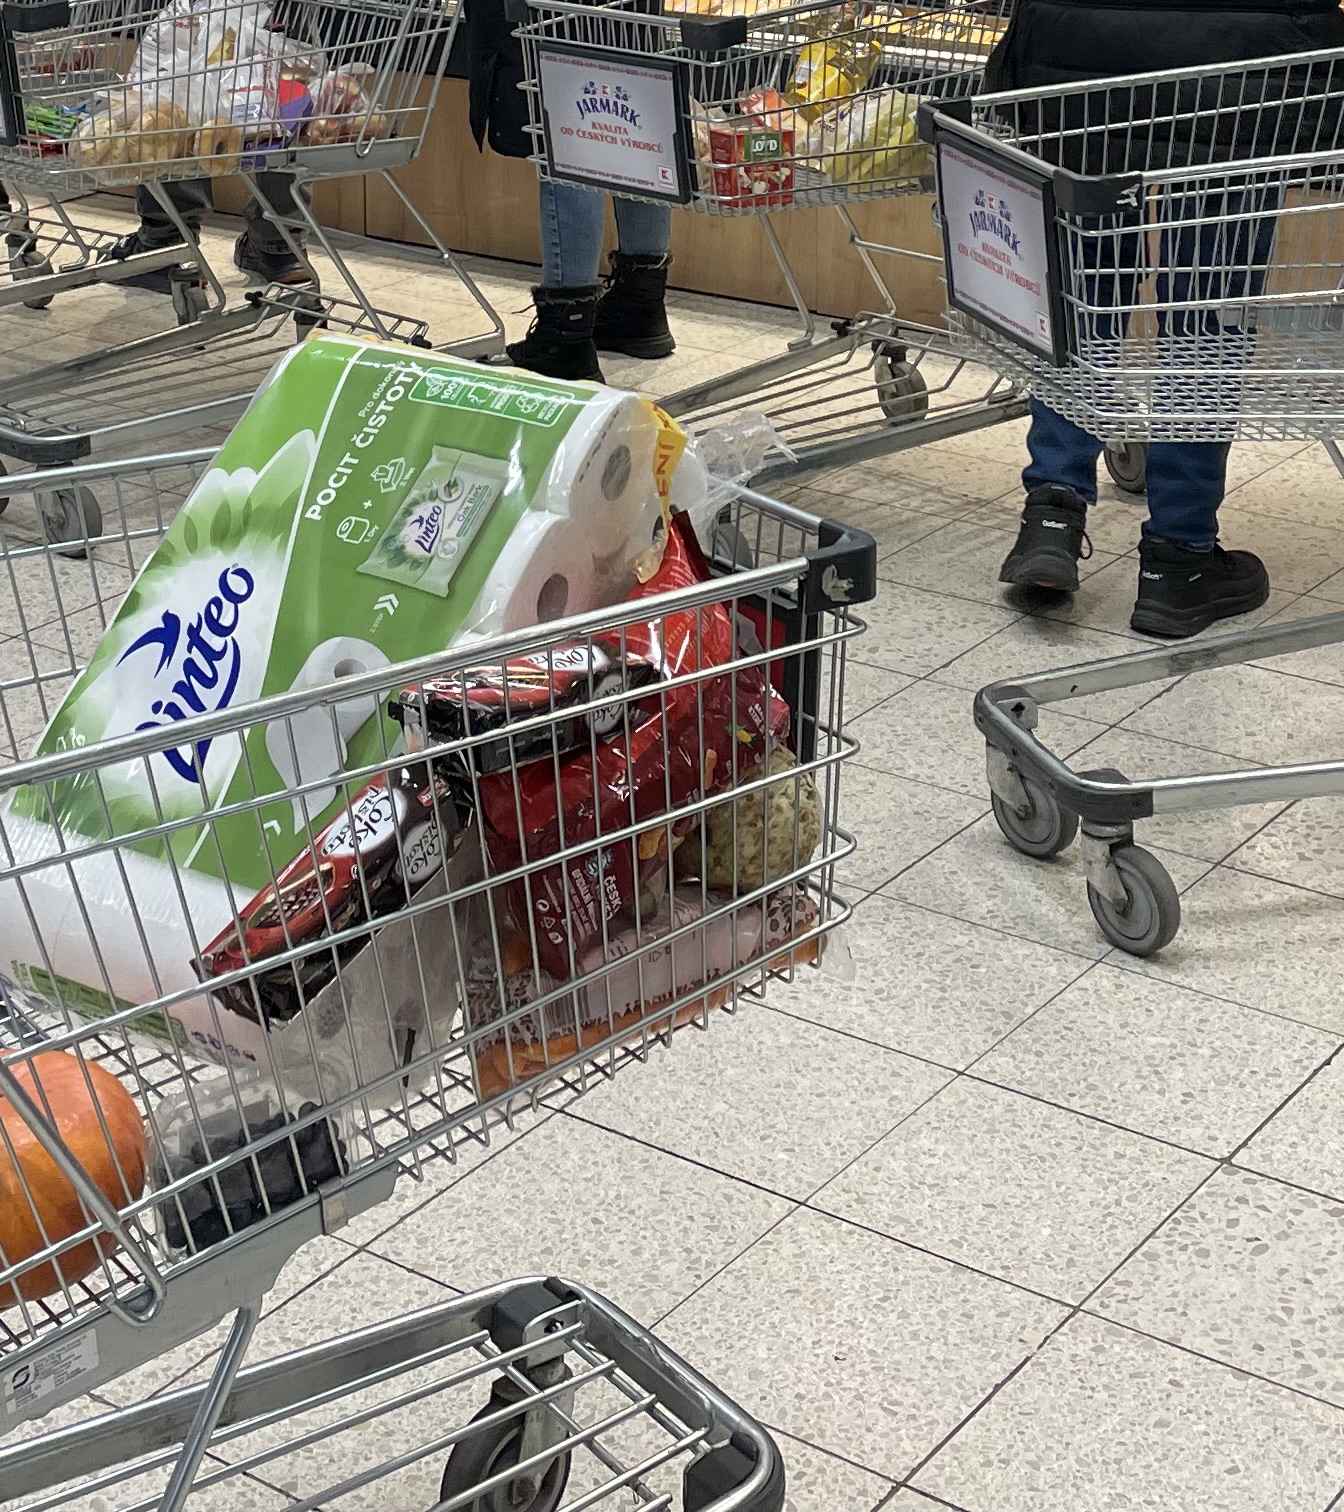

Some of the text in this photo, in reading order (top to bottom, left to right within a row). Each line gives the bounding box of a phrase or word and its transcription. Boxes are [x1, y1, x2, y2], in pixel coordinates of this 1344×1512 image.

[576, 97, 641, 128] JARMARK
[560, 126, 574, 137] OD
[591, 121, 629, 136] KVALITA
[969, 210, 1021, 257] JARMARK
[358, 401, 372, 419] Pro
[305, 361, 424, 521] POCIT ČISTOTY
[414, 505, 442, 554] Linteo
